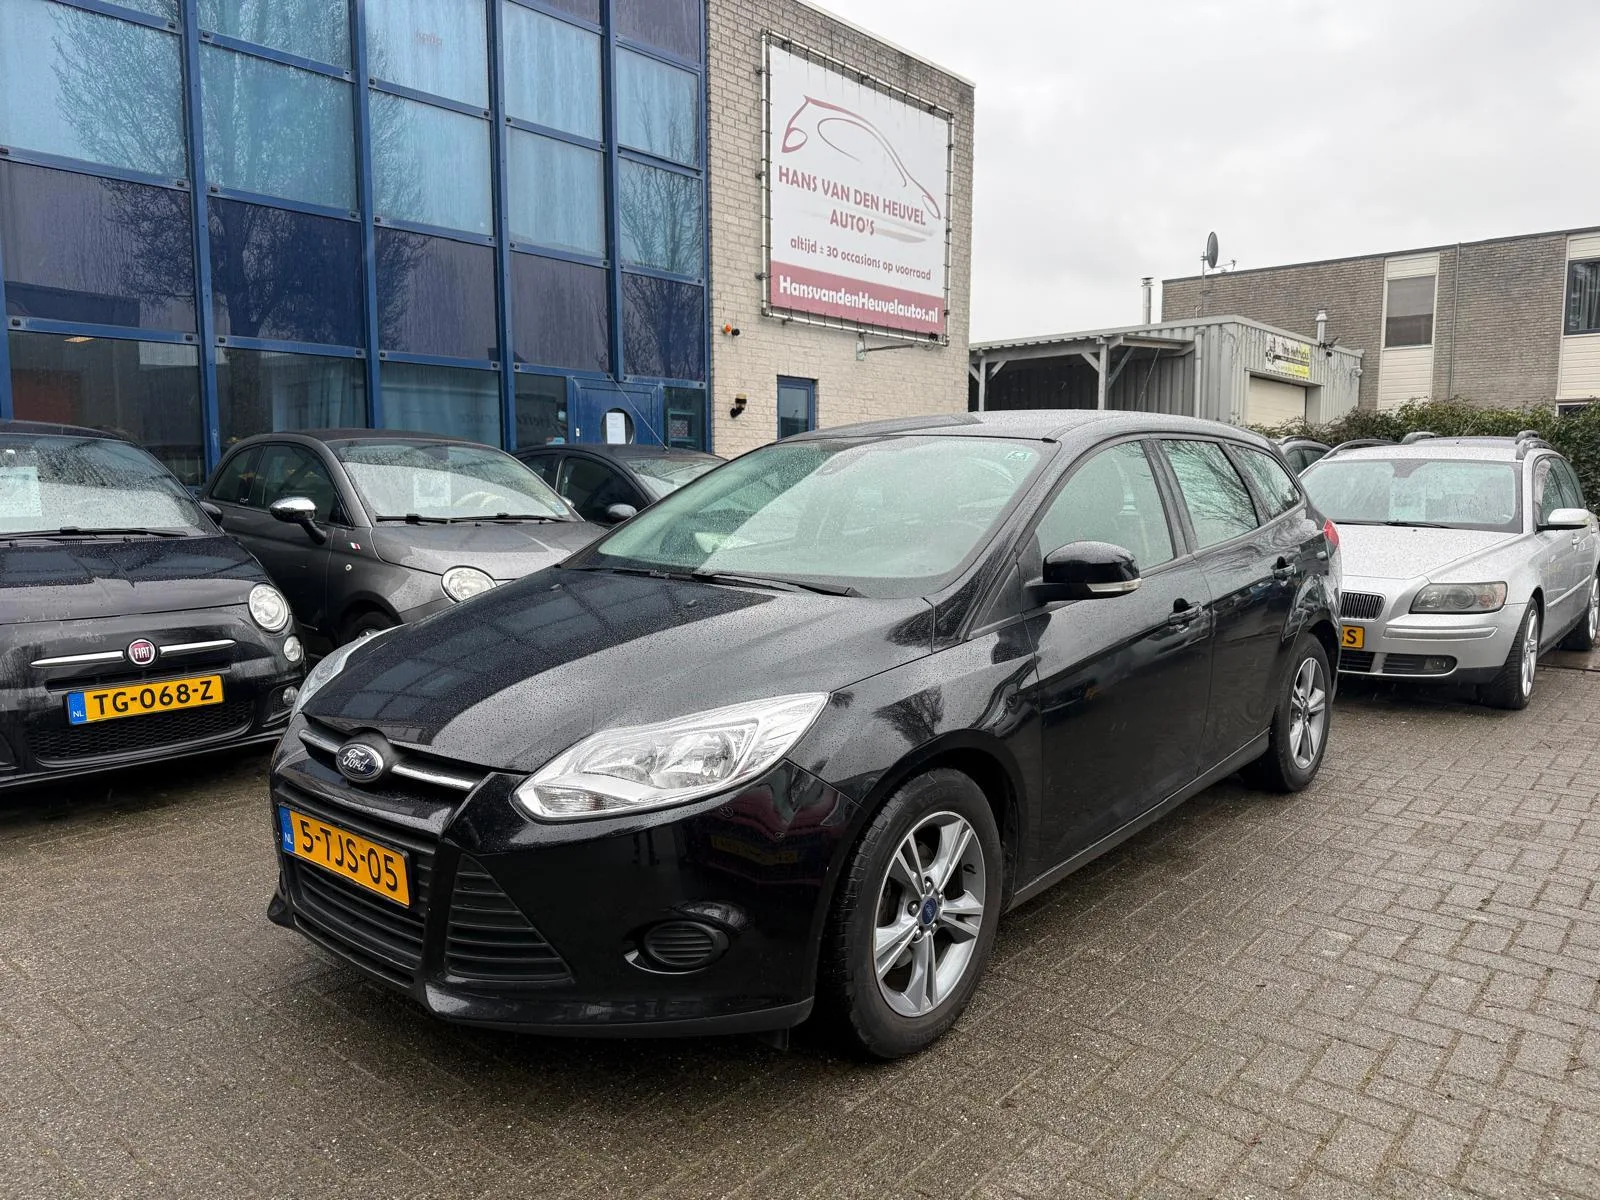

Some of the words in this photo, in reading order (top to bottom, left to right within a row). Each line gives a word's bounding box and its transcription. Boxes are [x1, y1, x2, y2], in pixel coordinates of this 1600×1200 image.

[778, 165, 817, 192] HANS
[822, 178, 850, 203] VAN
[854, 189, 880, 211] DEN
[883, 199, 926, 225] HEUVEL
[830, 209, 875, 236] AUTO'S
[790, 235, 817, 254] altijd
[826, 245, 838, 258] 30
[840, 251, 881, 269] occasions
[883, 261, 893, 273] op
[895, 264, 931, 280] voorraad
[779, 275, 939, 323] HansvandenHeuvelautos.nl
[134, 646, 150, 659] FIAT
[93, 680, 213, 715] TG-068-Z
[73, 710, 84, 718] NL
[342, 748, 370, 771] Ford
[284, 833, 293, 845] NL
[300, 819, 398, 892] 5-TJS-05
